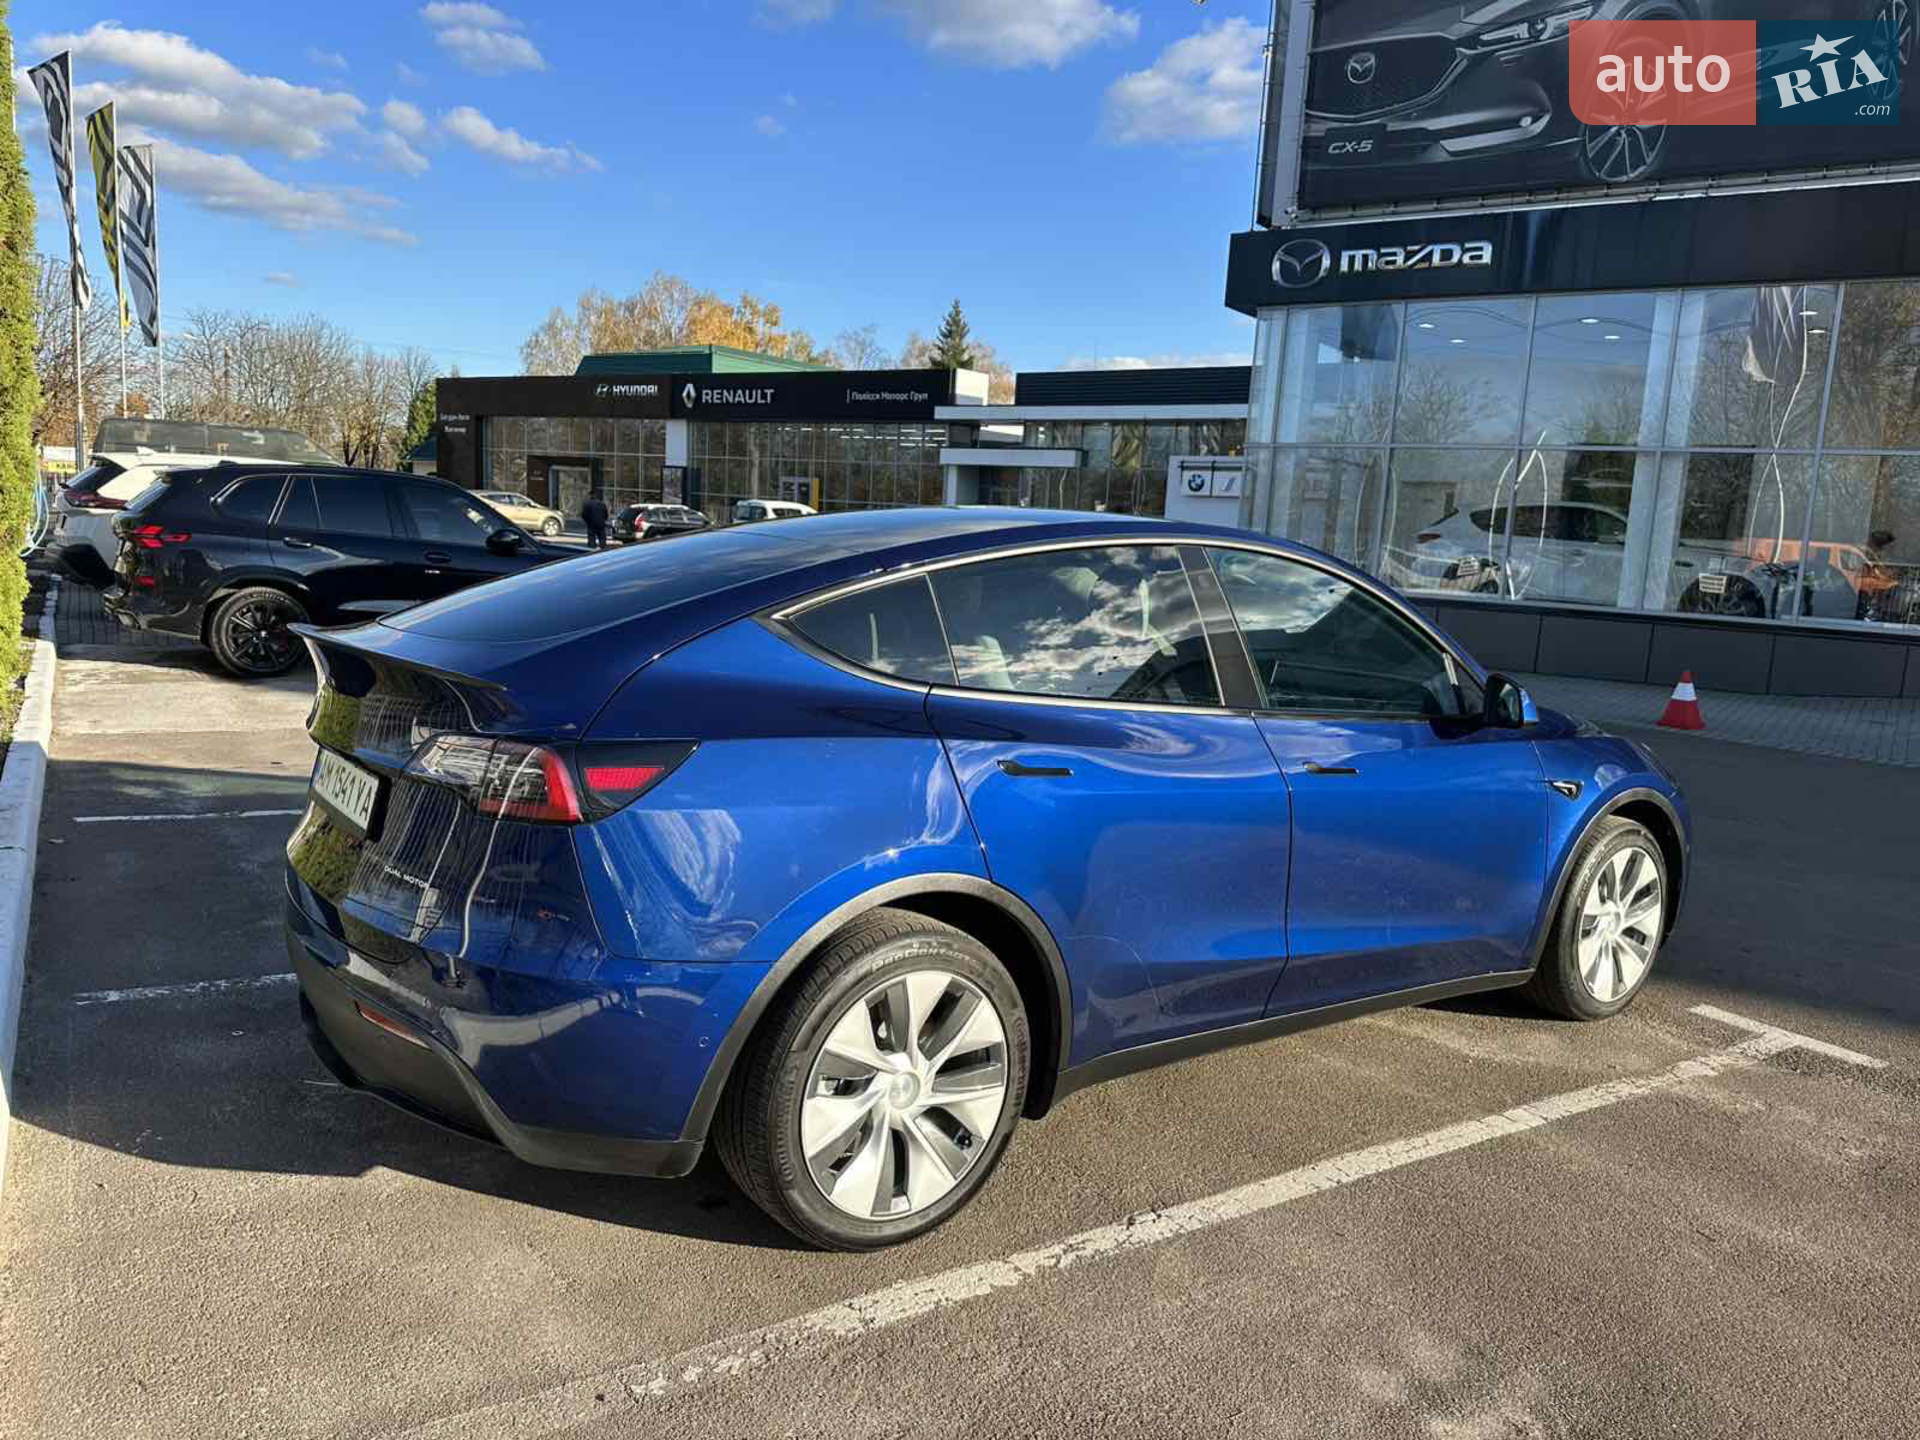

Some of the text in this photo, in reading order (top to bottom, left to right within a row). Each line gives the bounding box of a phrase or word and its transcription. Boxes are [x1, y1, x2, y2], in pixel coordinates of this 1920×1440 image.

[1327, 139, 1374, 155] CX-5
[612, 384, 659, 397] HYUNDAI
[701, 388, 775, 404] RENAULT
